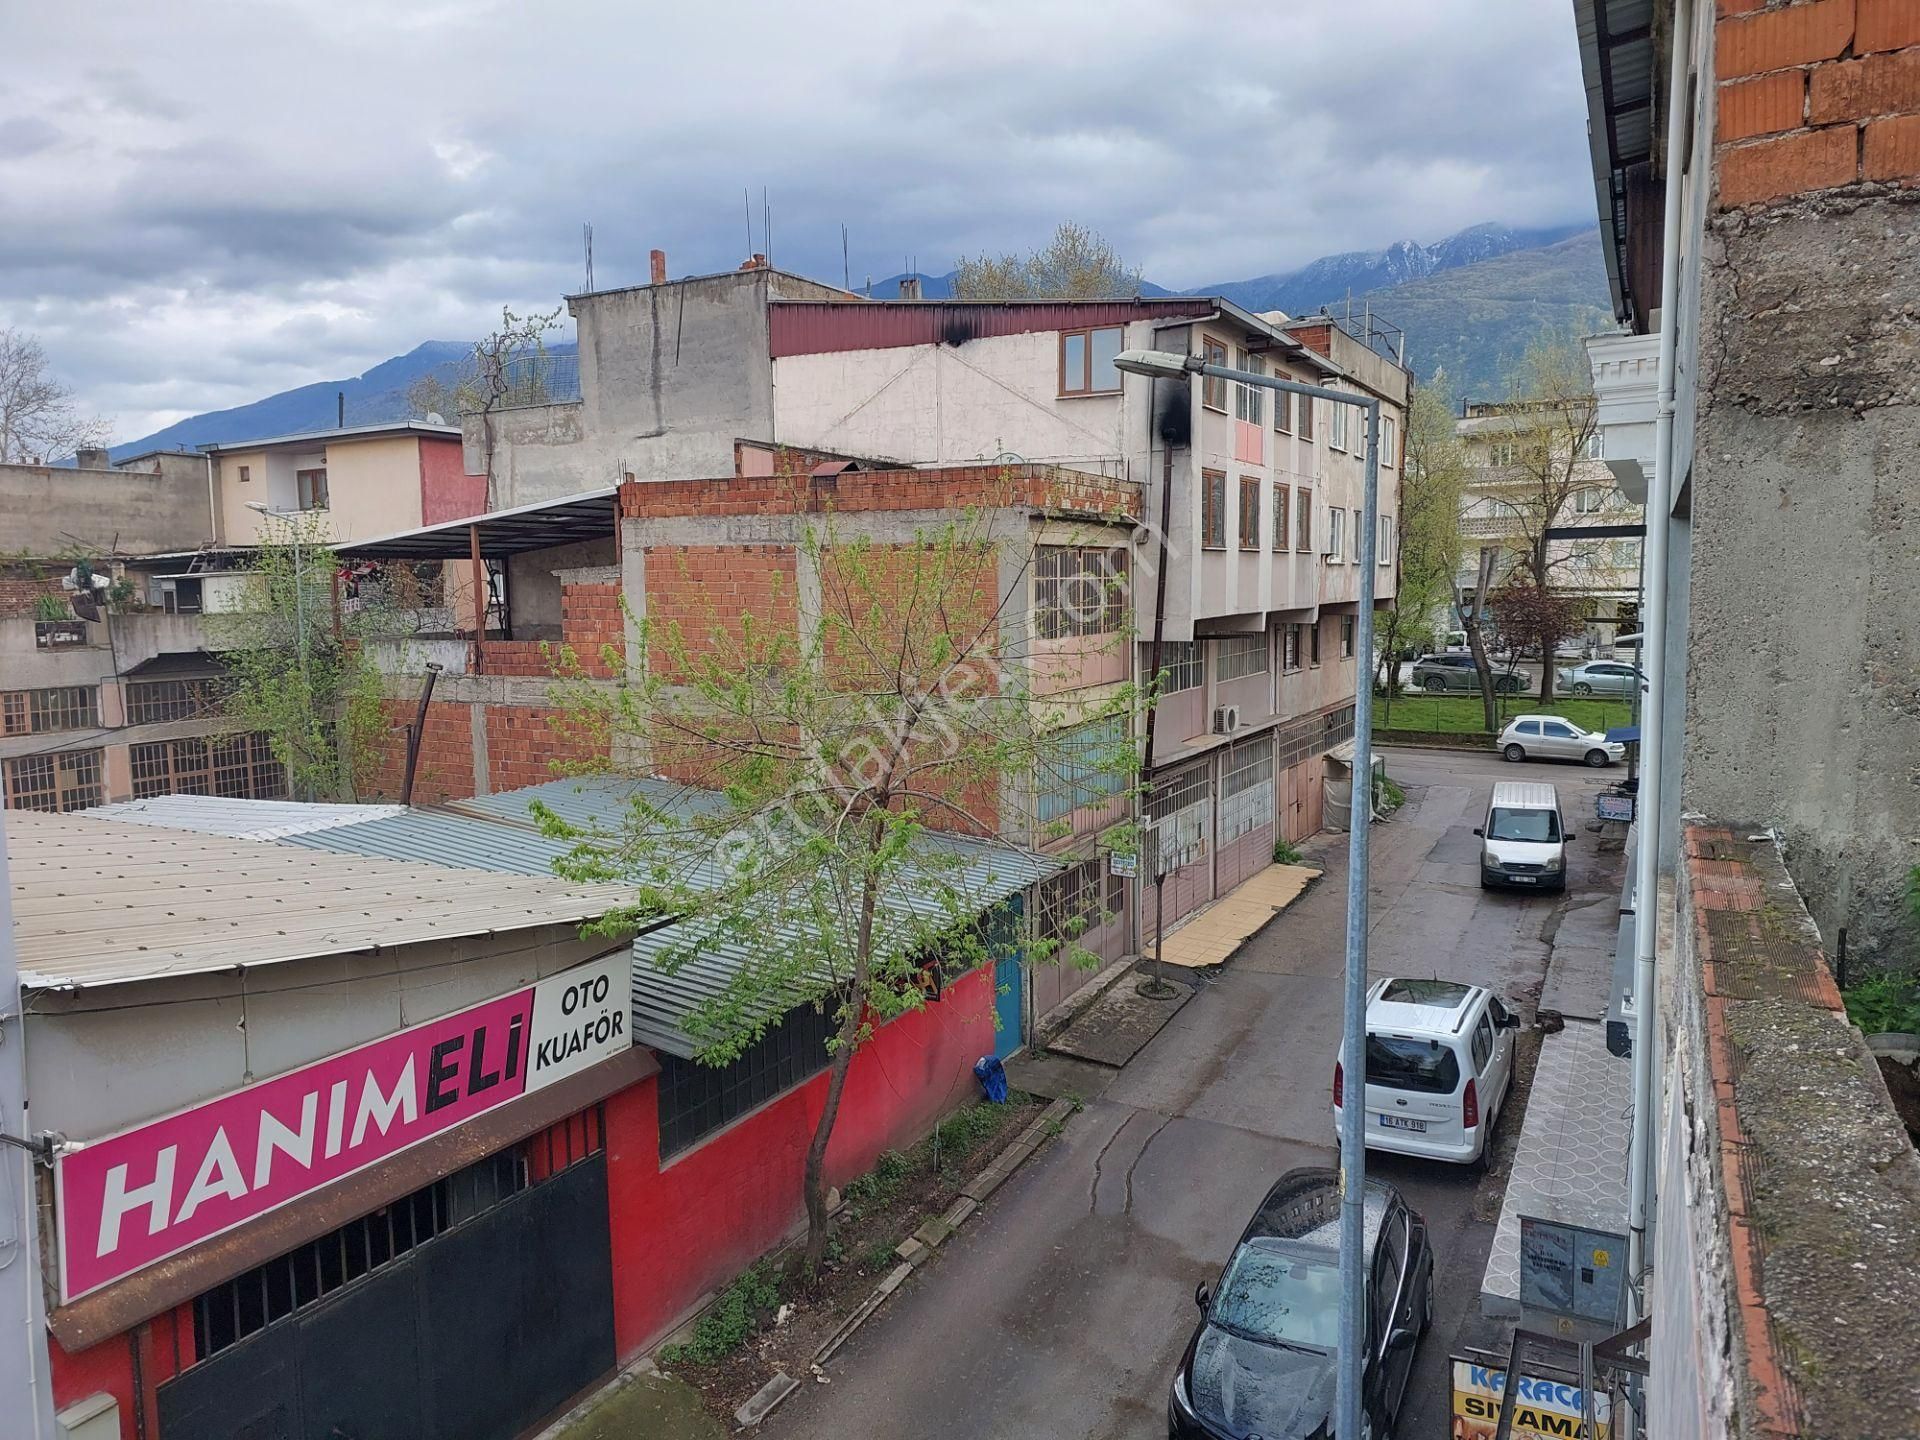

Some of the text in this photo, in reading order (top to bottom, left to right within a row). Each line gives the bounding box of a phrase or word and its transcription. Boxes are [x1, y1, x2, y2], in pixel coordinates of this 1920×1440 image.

[561, 974, 610, 1016] OTO
[536, 1008, 624, 1071] KUAFÖR
[1385, 1115, 1425, 1130] 16 ATK 918
